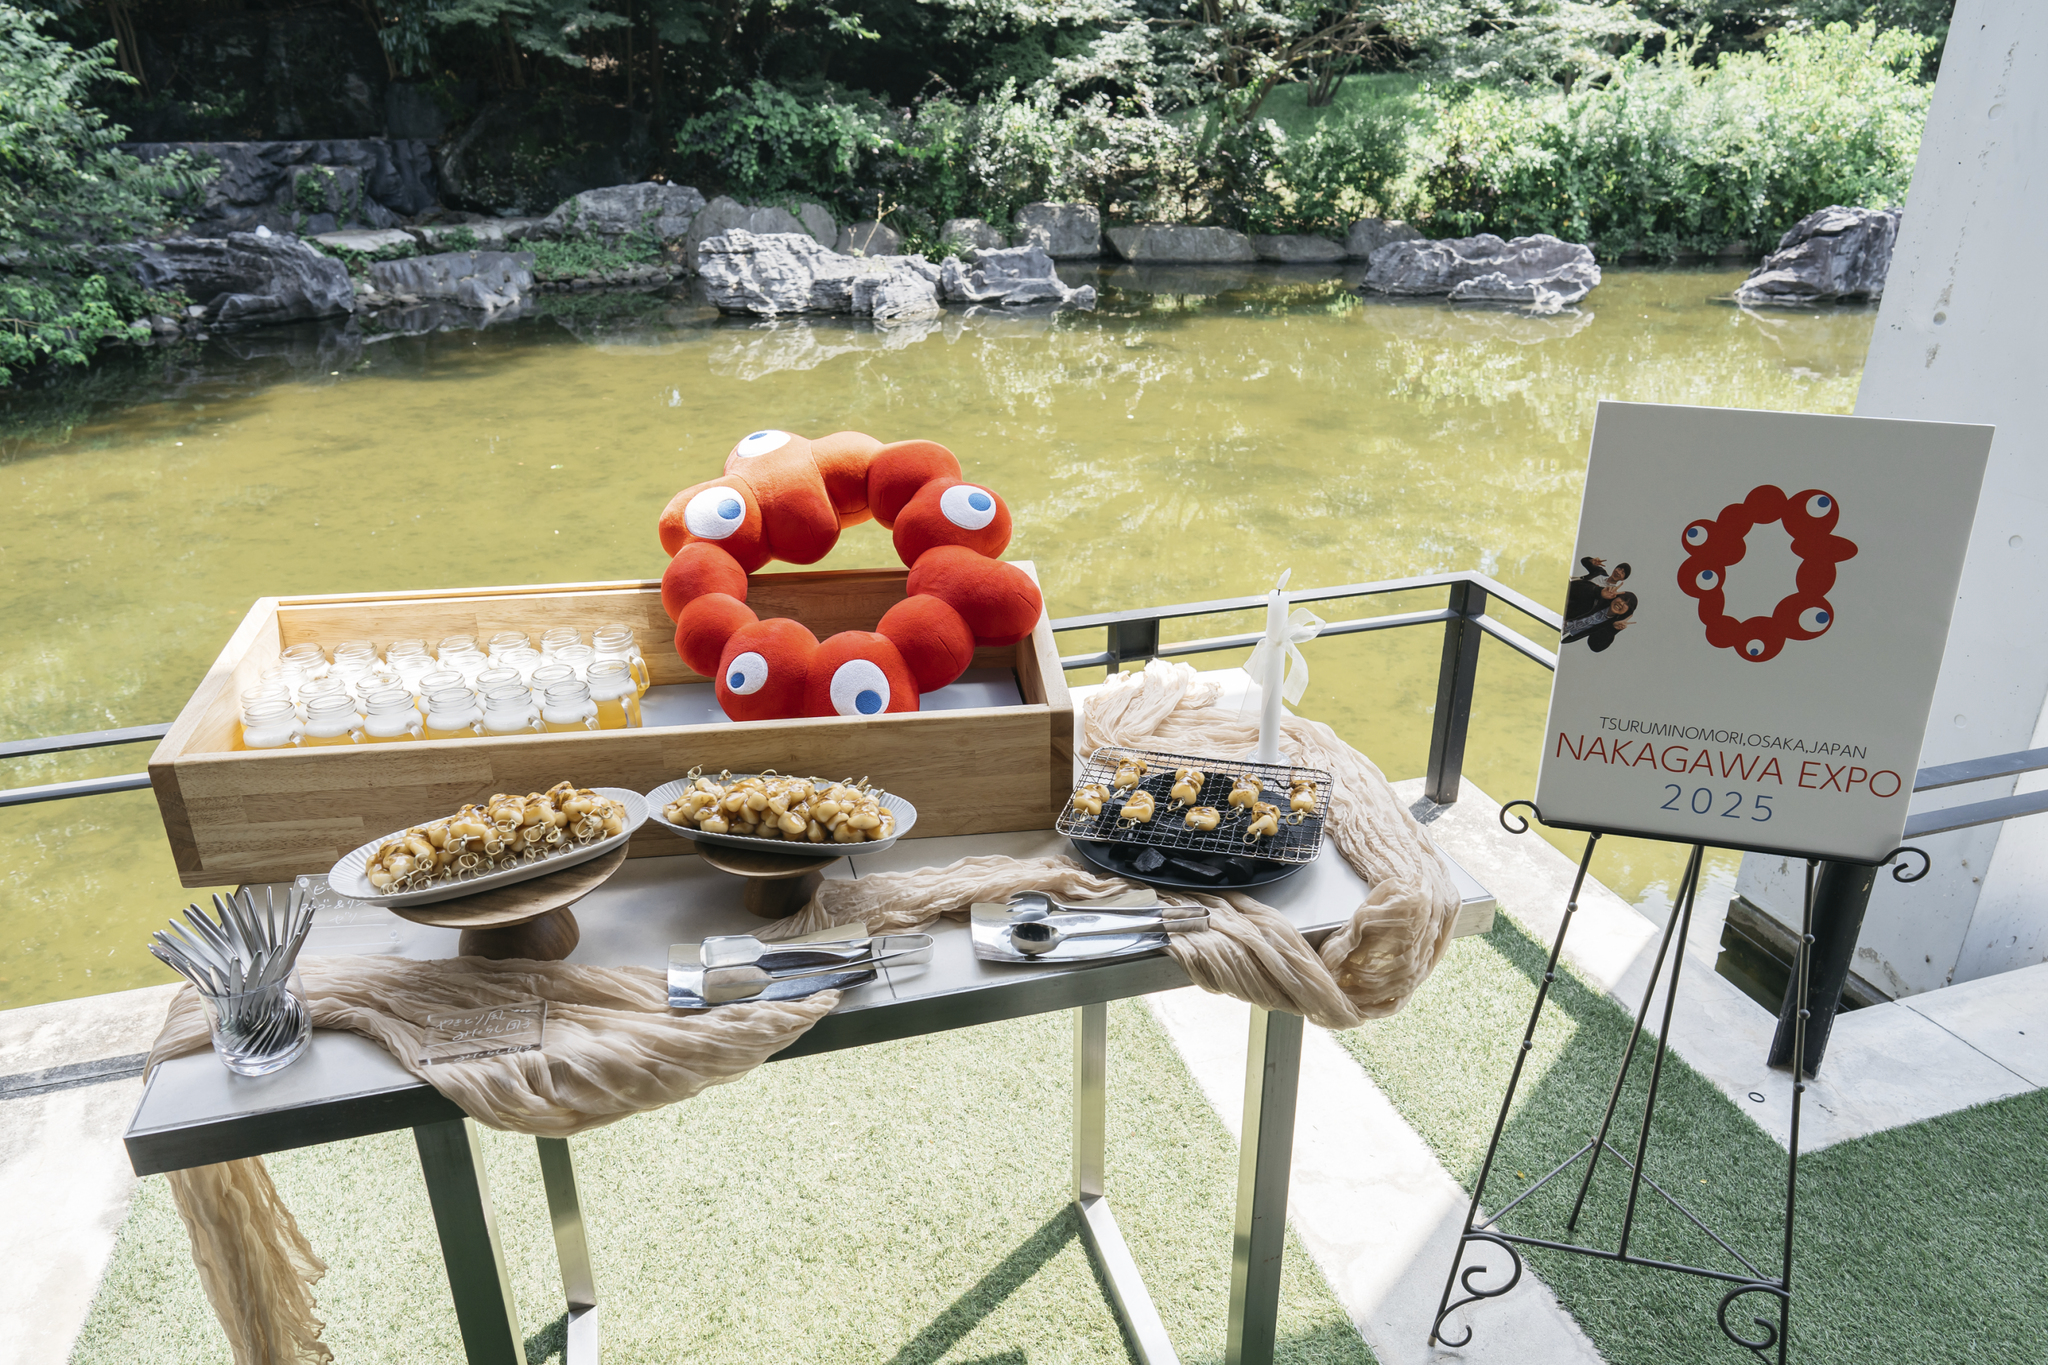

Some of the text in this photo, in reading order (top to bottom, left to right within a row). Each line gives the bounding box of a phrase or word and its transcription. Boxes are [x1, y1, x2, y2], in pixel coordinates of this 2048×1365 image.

[1556, 732, 1902, 798] NAKAGAWA EXPO
[1660, 783, 1774, 822] 2025
[436, 1010, 506, 1031] やきとり風
[452, 1018, 533, 1041] みたらし団子
